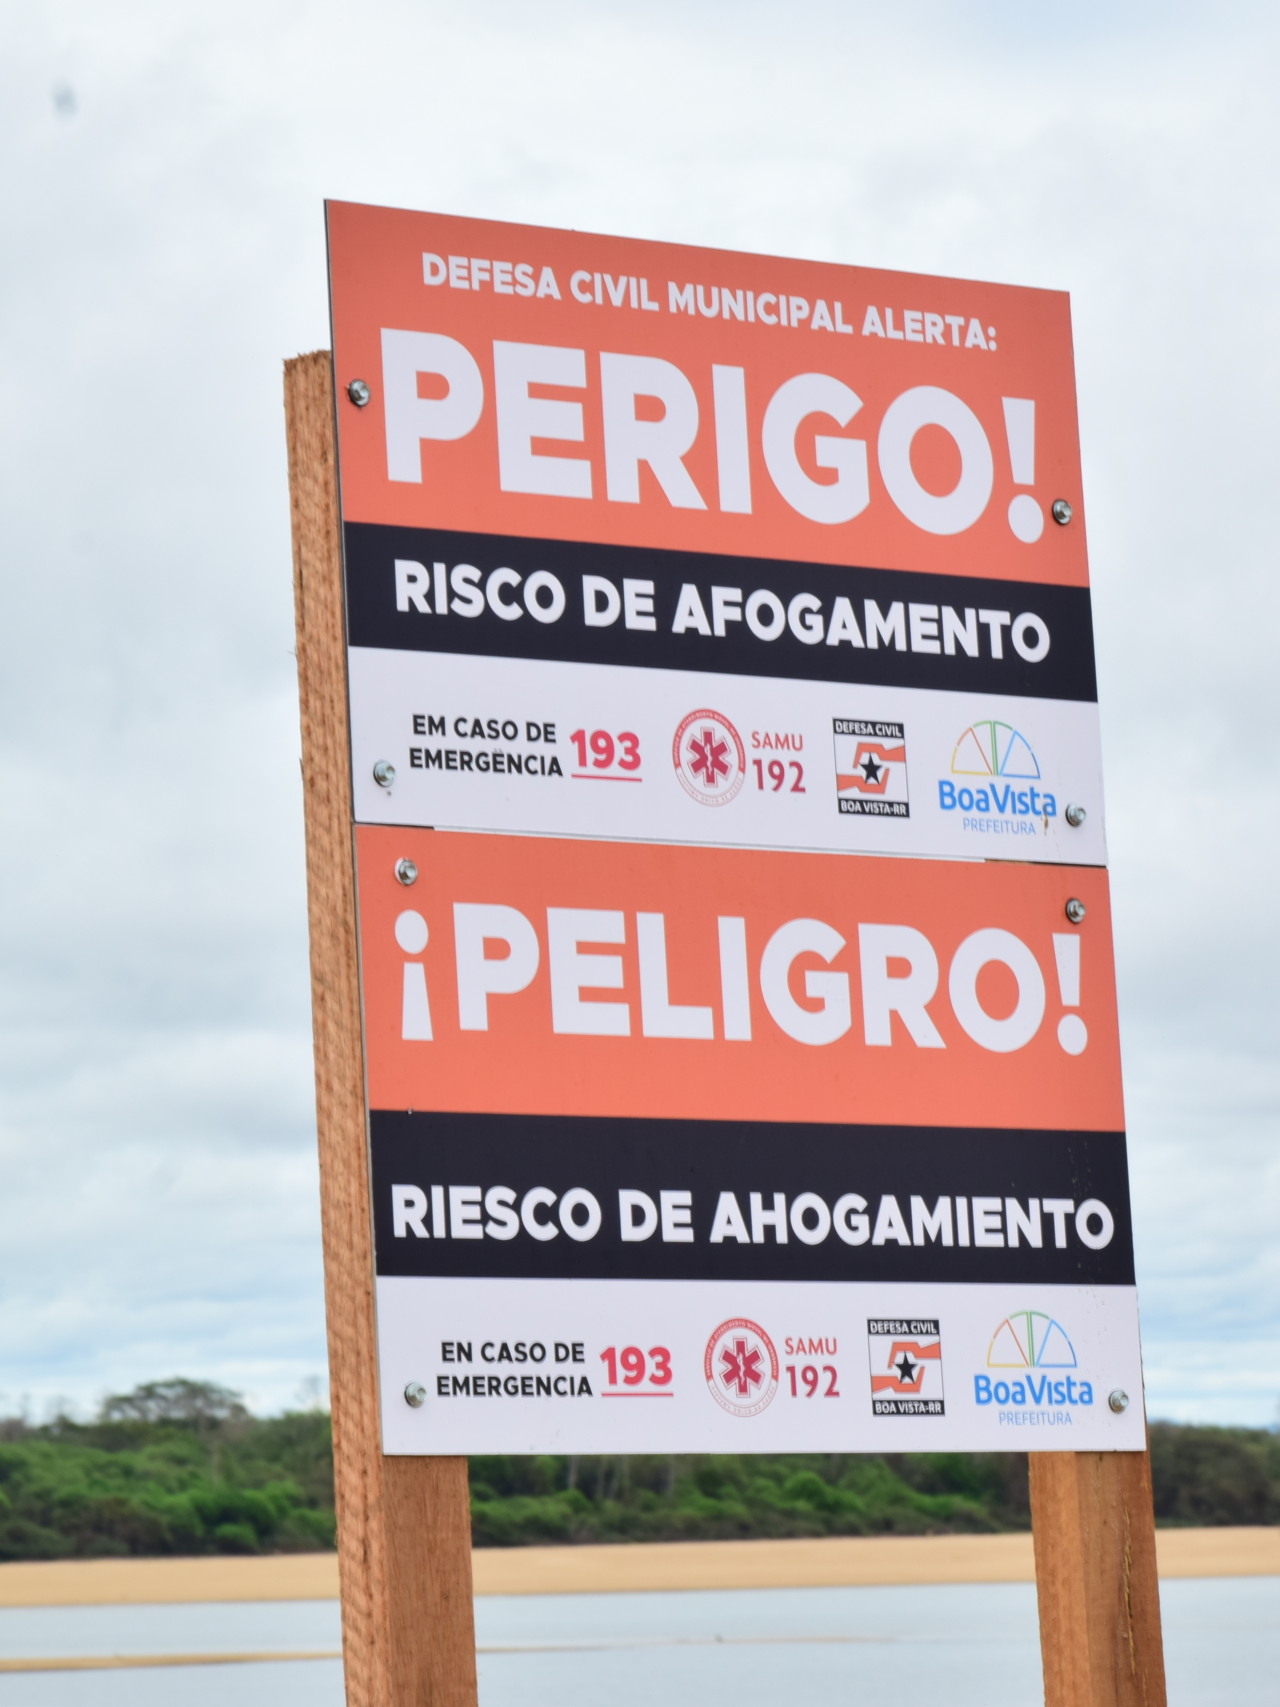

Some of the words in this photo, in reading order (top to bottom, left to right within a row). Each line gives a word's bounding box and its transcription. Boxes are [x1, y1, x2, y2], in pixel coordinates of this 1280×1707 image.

[423, 252, 562, 300] DEFESA
[569, 269, 660, 312] CIVIL
[667, 281, 854, 335] MUNICIPAL
[861, 305, 998, 352] ALERTA:
[380, 325, 1045, 544] PERIGO!
[394, 558, 566, 624] RISCO
[582, 574, 657, 632] DE
[671, 583, 1051, 663] AFOGAMENTO
[412, 714, 446, 737] EM
[453, 716, 519, 741] CASO
[525, 721, 557, 743] DE
[751, 731, 804, 752] SAMU
[835, 720, 874, 736] DEFESA
[876, 723, 903, 738] CIVIL
[569, 729, 642, 771] 193
[752, 759, 806, 794] 192
[841, 801, 863, 814] BOA
[864, 802, 907, 816] VISTA-RR
[963, 817, 1036, 835] PREFEITURA
[394, 902, 1089, 1056] ¡PELIGRO!
[391, 1184, 602, 1242] RIESCO
[618, 1189, 694, 1243] DE
[709, 1191, 1115, 1250] AHOGAMIENTO
[869, 1320, 910, 1334] DEFESA
[910, 1321, 937, 1334] CIVIL
[441, 1341, 473, 1363] EN
[480, 1341, 547, 1364] CASO
[554, 1342, 585, 1363] DE
[785, 1337, 838, 1356] SAMU
[600, 1345, 673, 1386] 193
[436, 1375, 593, 1397] EMERGENCIA
[786, 1365, 840, 1399] 192
[875, 1402, 896, 1414] BOA
[898, 1402, 942, 1415] VISTA-RR
[999, 1410, 1072, 1426] PREFEITURA
